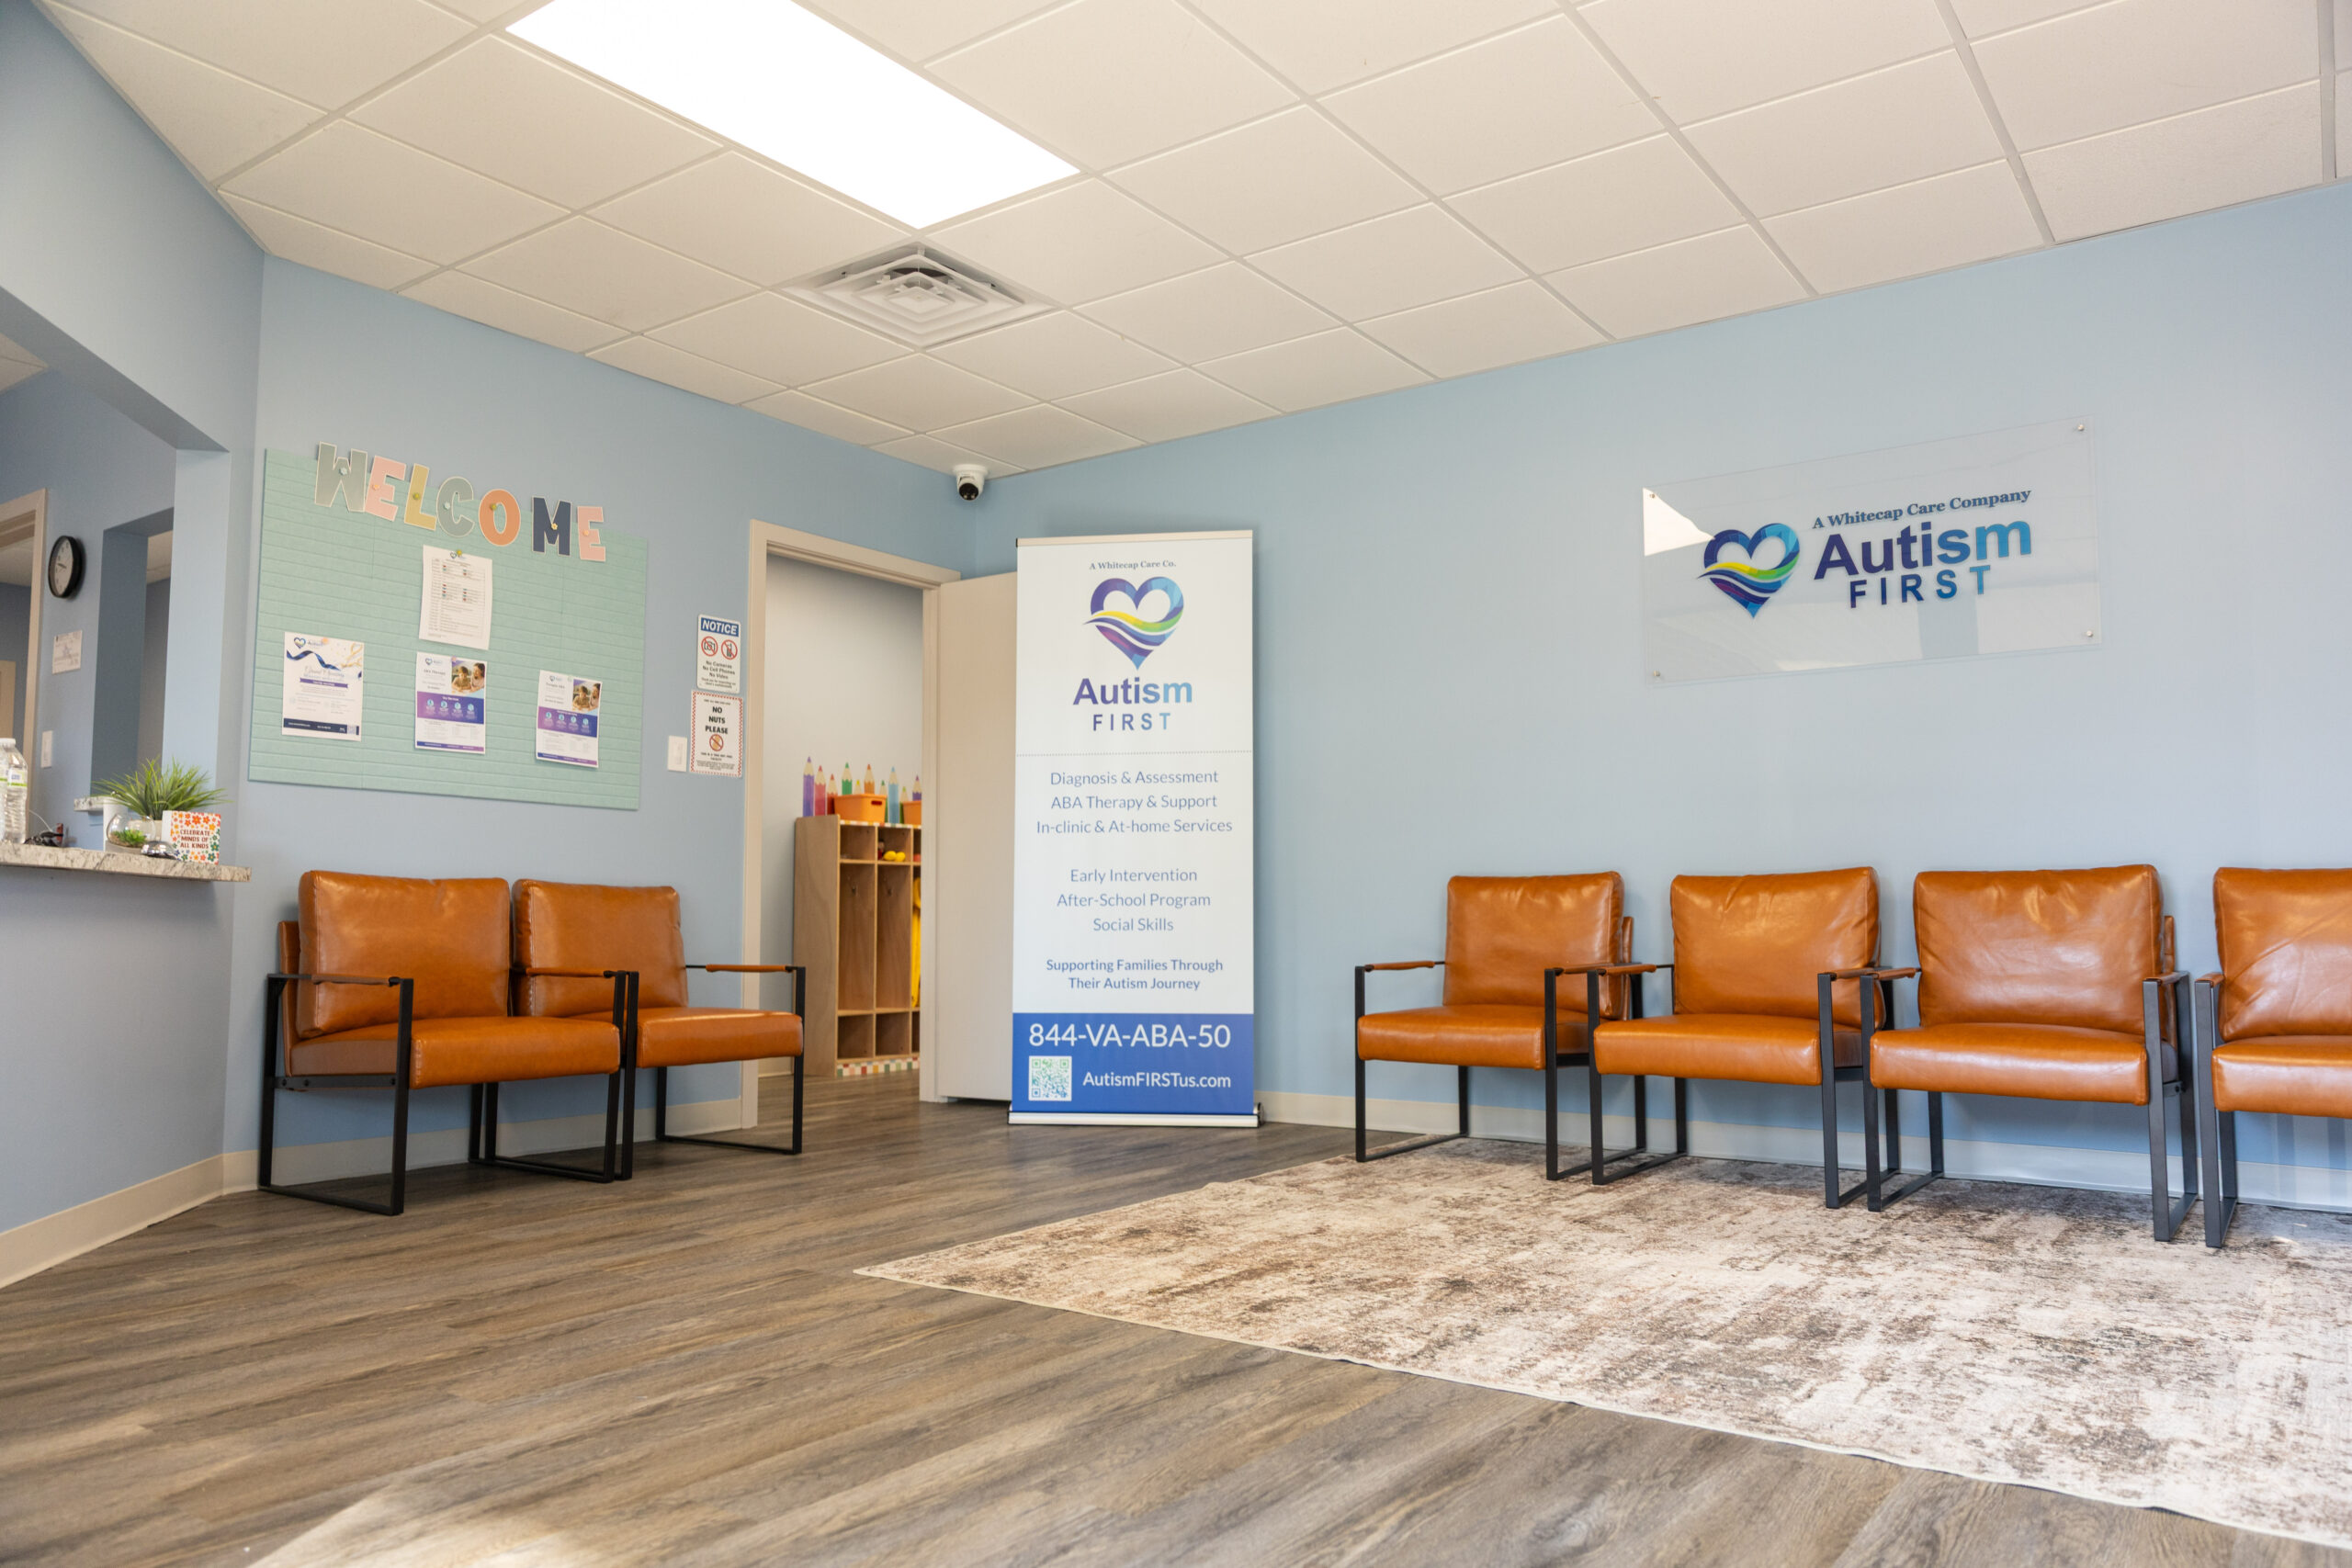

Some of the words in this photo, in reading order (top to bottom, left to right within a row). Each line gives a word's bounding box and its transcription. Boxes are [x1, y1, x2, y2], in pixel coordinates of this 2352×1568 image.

[315, 442, 605, 561] WELCOME
[1812, 517, 1825, 529] A
[1827, 508, 1903, 526] Whitecap
[1907, 502, 1946, 516] Care
[1950, 490, 2032, 509] Company
[1814, 520, 2031, 581] Autism
[1098, 561, 1138, 570] Whitecap
[1162, 559, 1176, 568] Co.
[1849, 565, 1991, 609] FIRST
[702, 619, 738, 636] NOTICE
[1072, 677, 1193, 705] Autism
[708, 716, 726, 724] NUTS
[1093, 713, 1170, 731] FIRST
[705, 725, 729, 734] PLEASE
[1050, 772, 1117, 787] Diagnosis
[1121, 772, 1132, 784] &
[1135, 771, 1218, 784] Assessment
[1051, 796, 1082, 809] ABA
[1086, 795, 1143, 810] Therapy
[1147, 795, 1158, 808] &
[1160, 795, 1217, 810] Support
[1036, 820, 1091, 833] In-clinic
[1094, 820, 1105, 833] &
[1108, 819, 1170, 832] At-home
[1174, 818, 1233, 832] Services
[1070, 869, 1106, 885] Early
[1110, 868, 1197, 882] Intervention
[1057, 893, 1146, 907] After-School
[1149, 894, 1211, 908] Program
[1093, 918, 1134, 931] Social
[1137, 918, 1174, 931] Skills
[1046, 959, 1114, 973] Supporting
[1116, 959, 1168, 971] Families
[1170, 959, 1223, 973] Through
[1069, 976, 1101, 989] Their
[1103, 976, 1148, 989] Autism
[1150, 977, 1200, 991] Journey
[1029, 1023, 1231, 1048] 844-VA-ABA-50
[1082, 1071, 1231, 1089] AutismFIRSTus.com
